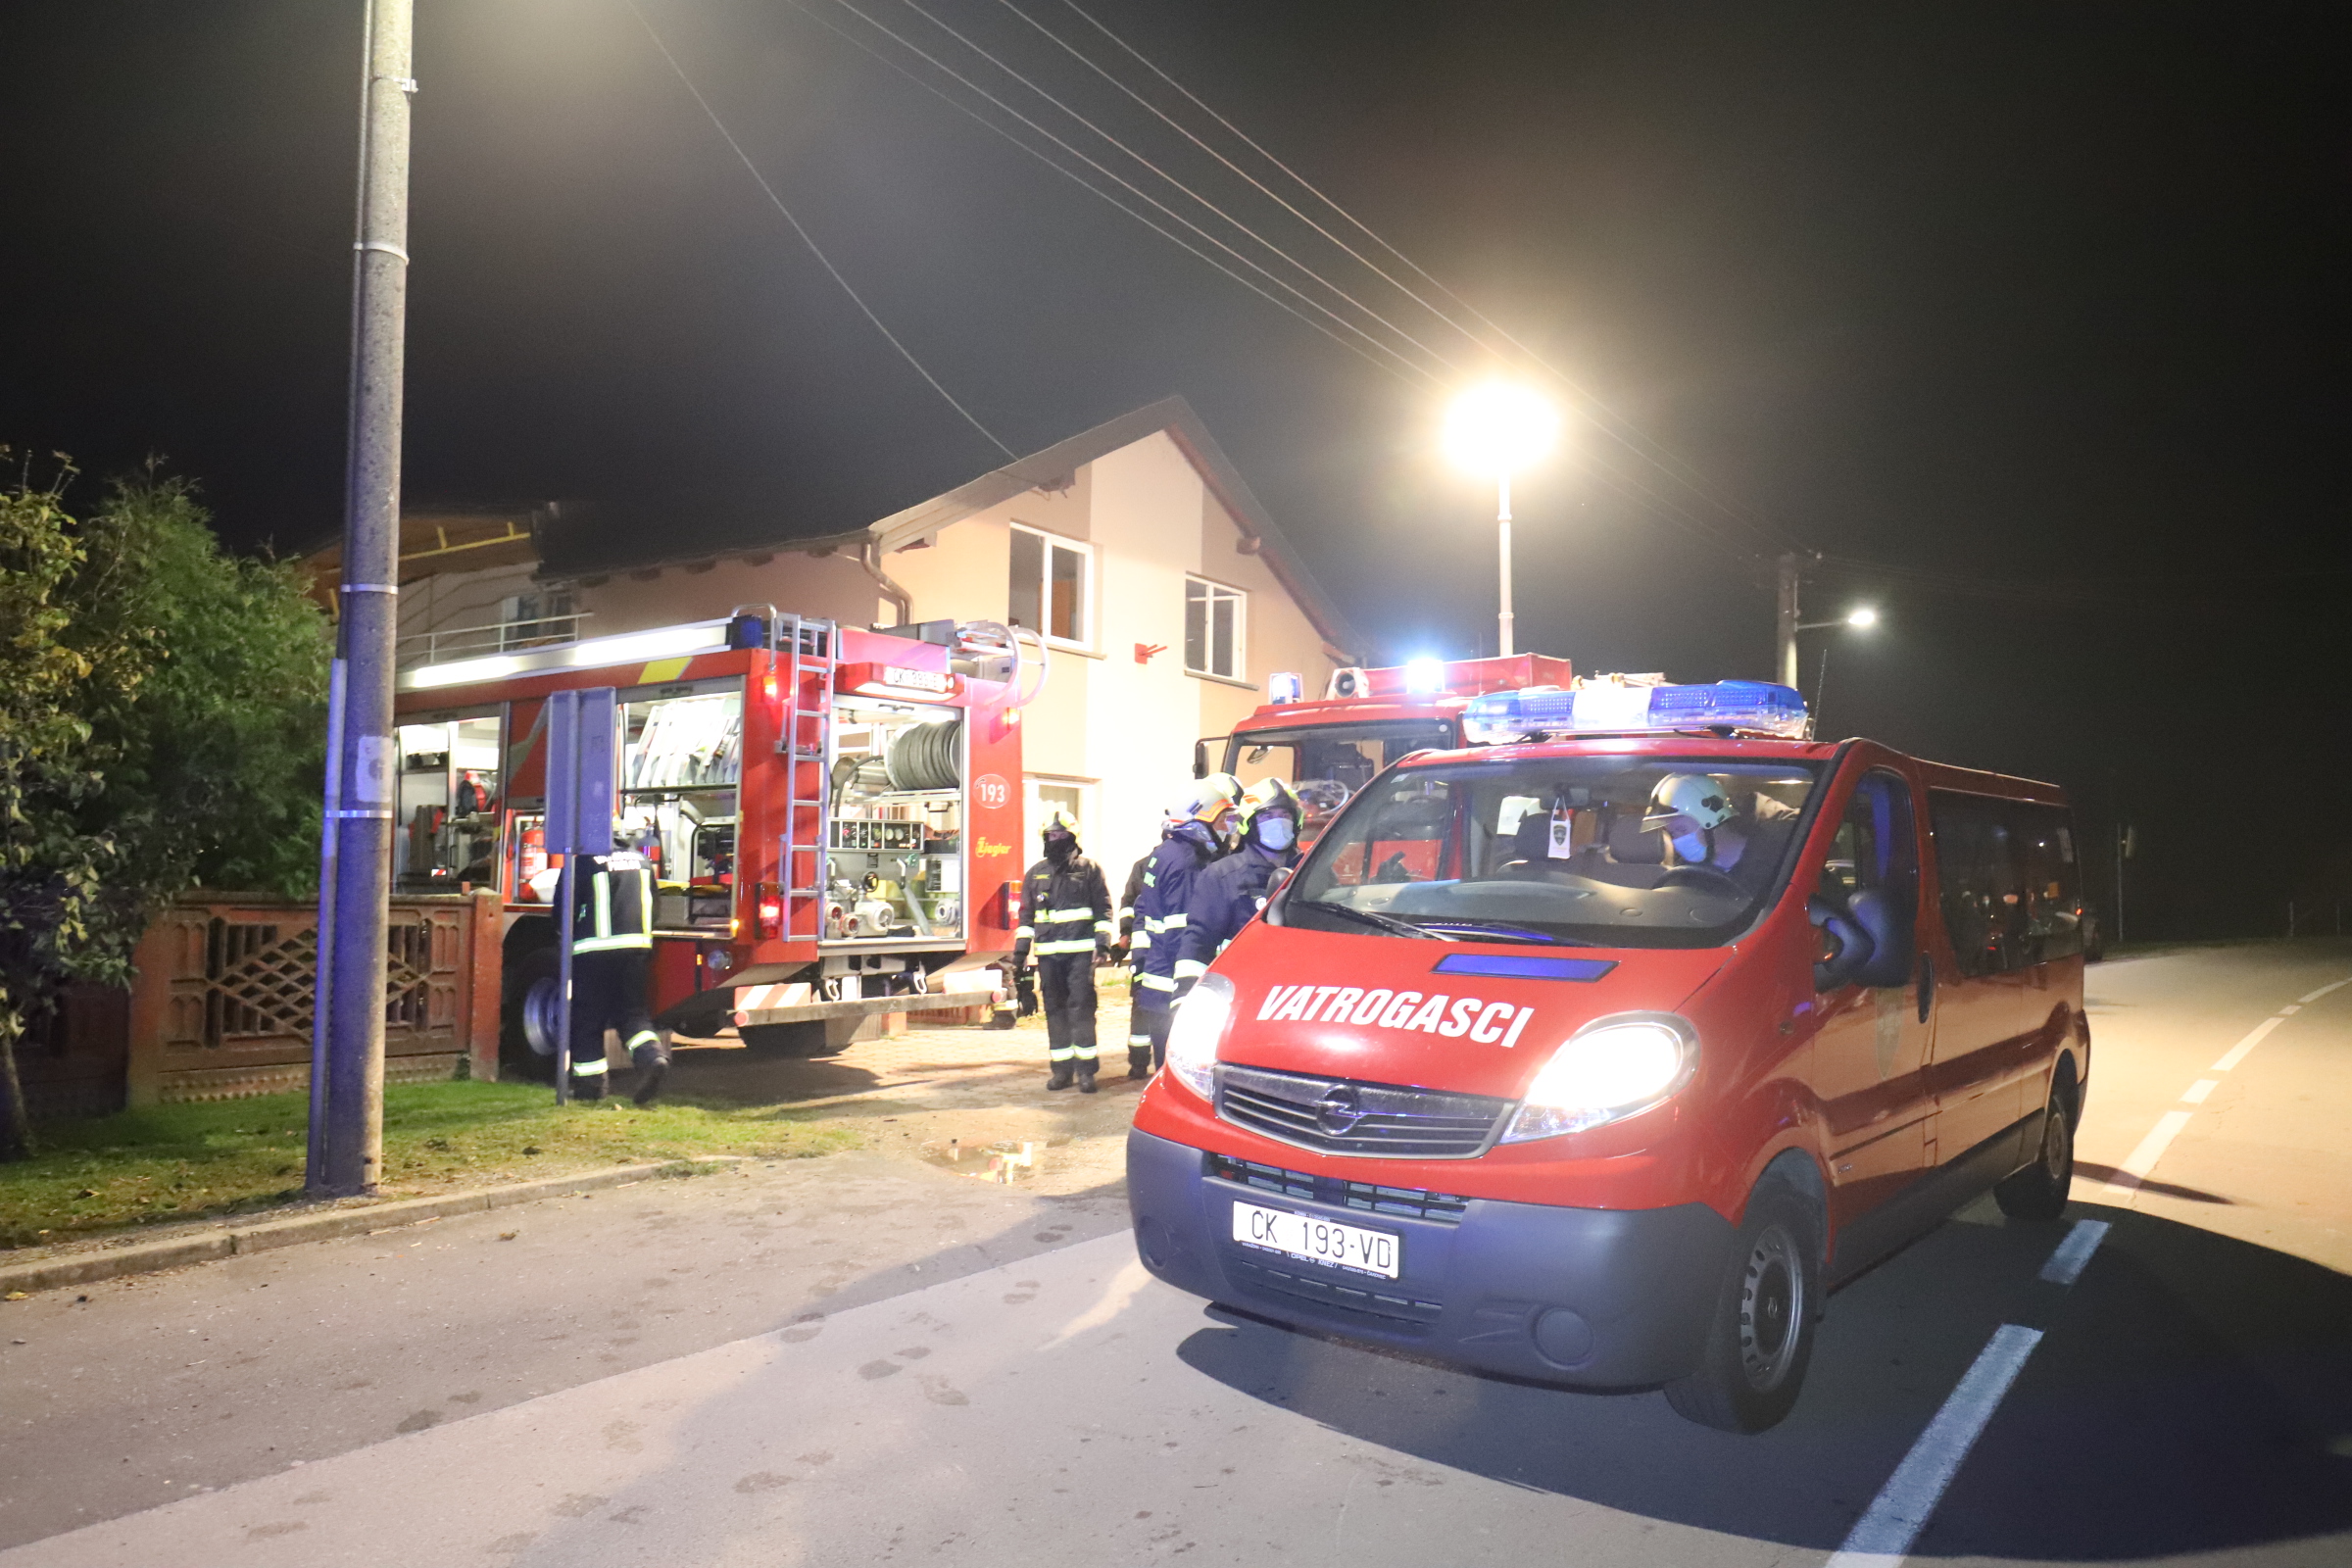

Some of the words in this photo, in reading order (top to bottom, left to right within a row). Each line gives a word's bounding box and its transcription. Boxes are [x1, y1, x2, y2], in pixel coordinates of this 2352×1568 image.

[980, 783, 1005, 803] 193
[1255, 985, 1536, 1049] VATROGASCI
[1290, 1252, 1309, 1262] OPEL
[1302, 1221, 1392, 1269] 193-VD
